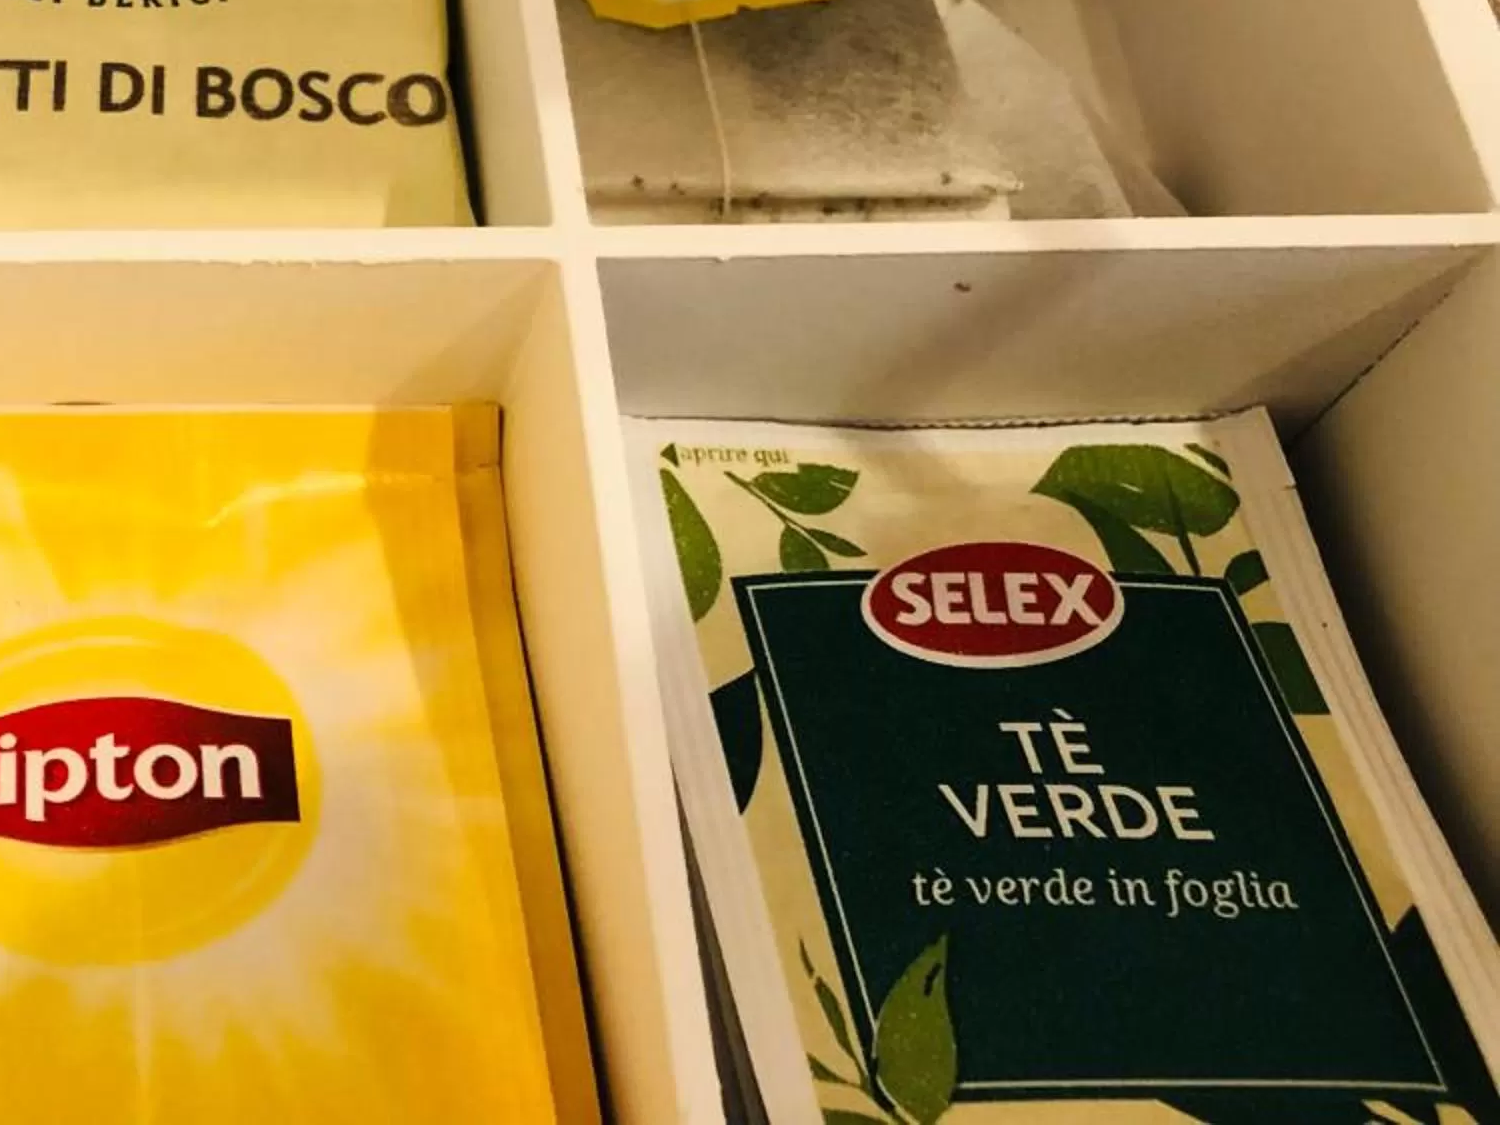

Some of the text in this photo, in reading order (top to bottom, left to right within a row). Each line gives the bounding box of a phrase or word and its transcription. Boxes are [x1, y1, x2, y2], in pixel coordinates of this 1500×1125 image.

[99, 61, 166, 115] DI
[195, 65, 449, 127] BOSCO
[890, 572, 1101, 627] SELEX
[999, 708, 1104, 776] TÈ
[937, 784, 1216, 841] VERDE
[911, 868, 1300, 919] tè verde in foglia
